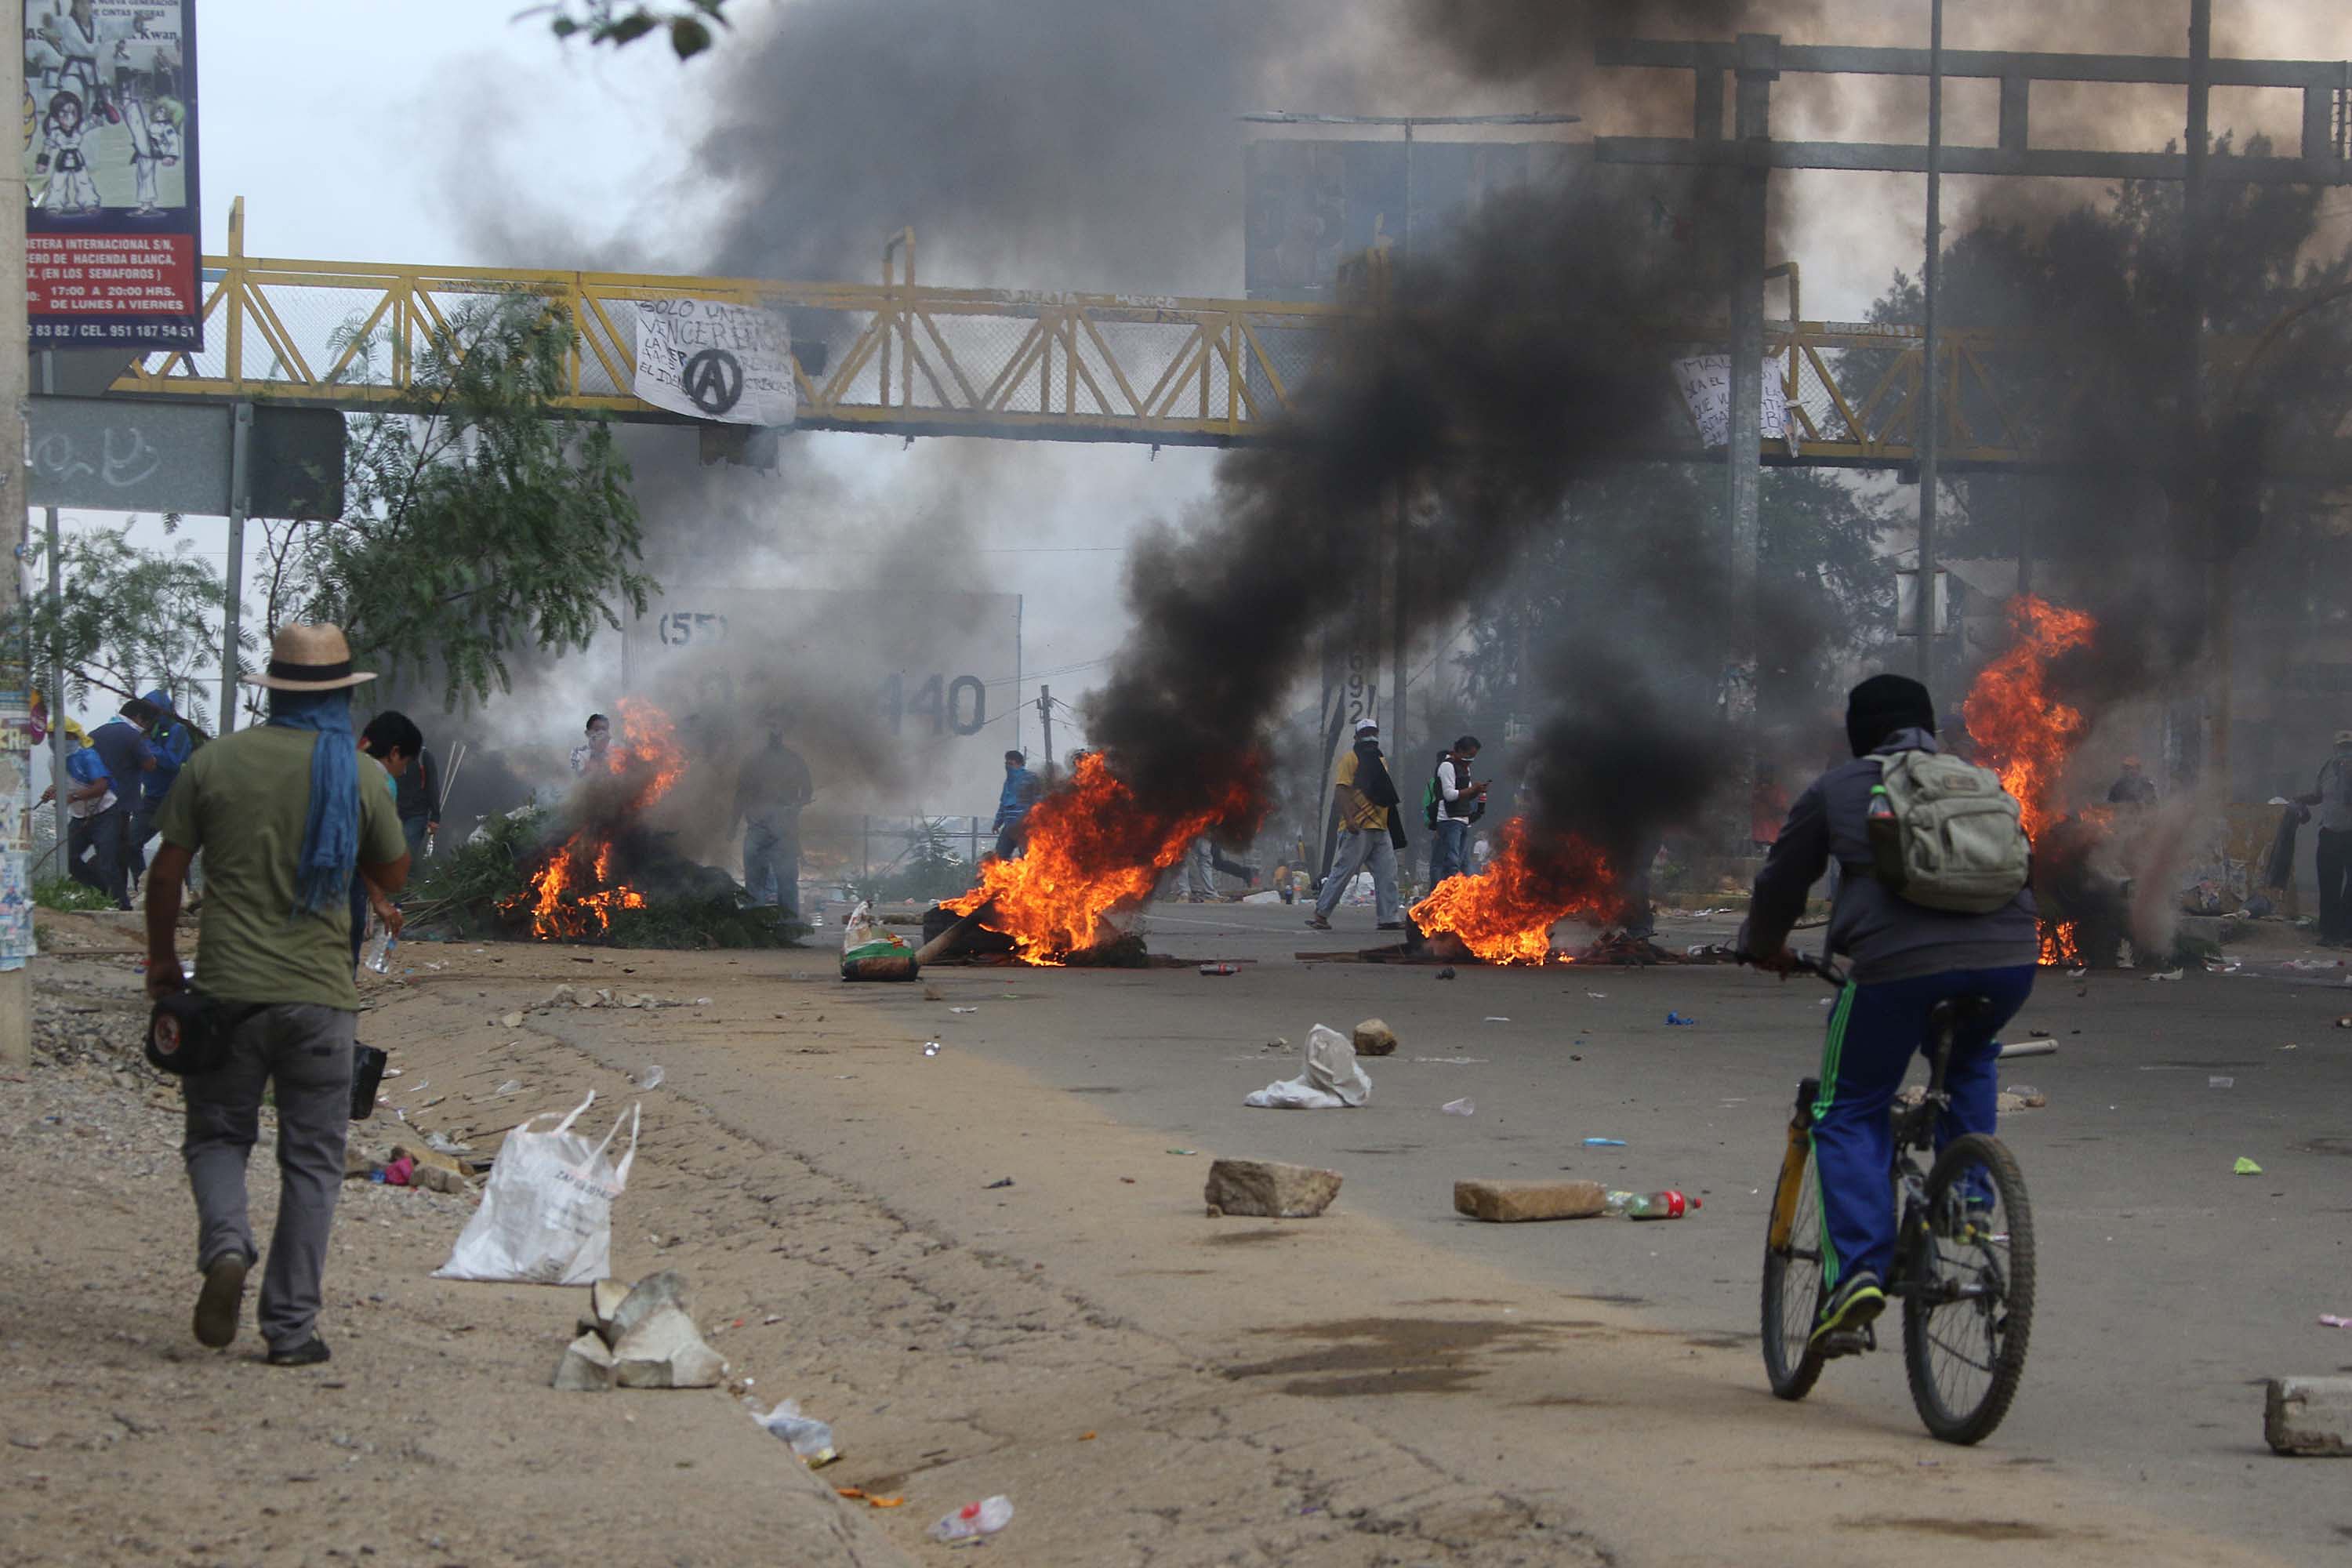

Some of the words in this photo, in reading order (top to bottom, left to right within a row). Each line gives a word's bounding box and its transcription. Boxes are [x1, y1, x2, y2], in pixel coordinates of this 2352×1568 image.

[66, 238, 150, 250] INTERNACIONAL
[53, 254, 67, 264] DE
[74, 253, 126, 264] HACIENDA
[42, 268, 60, 281] (EN
[63, 268, 82, 279] LOS
[89, 268, 154, 279] SEMAFOROS
[50, 286, 85, 296] 17:00
[92, 286, 101, 296] A
[107, 287, 142, 296] 20:00
[145, 287, 176, 296] HRS.
[50, 299, 68, 310] DE
[71, 300, 113, 310] LUNES
[117, 300, 126, 310] A
[129, 300, 184, 310] VIERNES
[638, 299, 695, 318] SOLO
[81, 325, 107, 337] CEL.
[109, 325, 132, 337] 951
[137, 325, 157, 337] 187
[640, 361, 655, 376] EL
